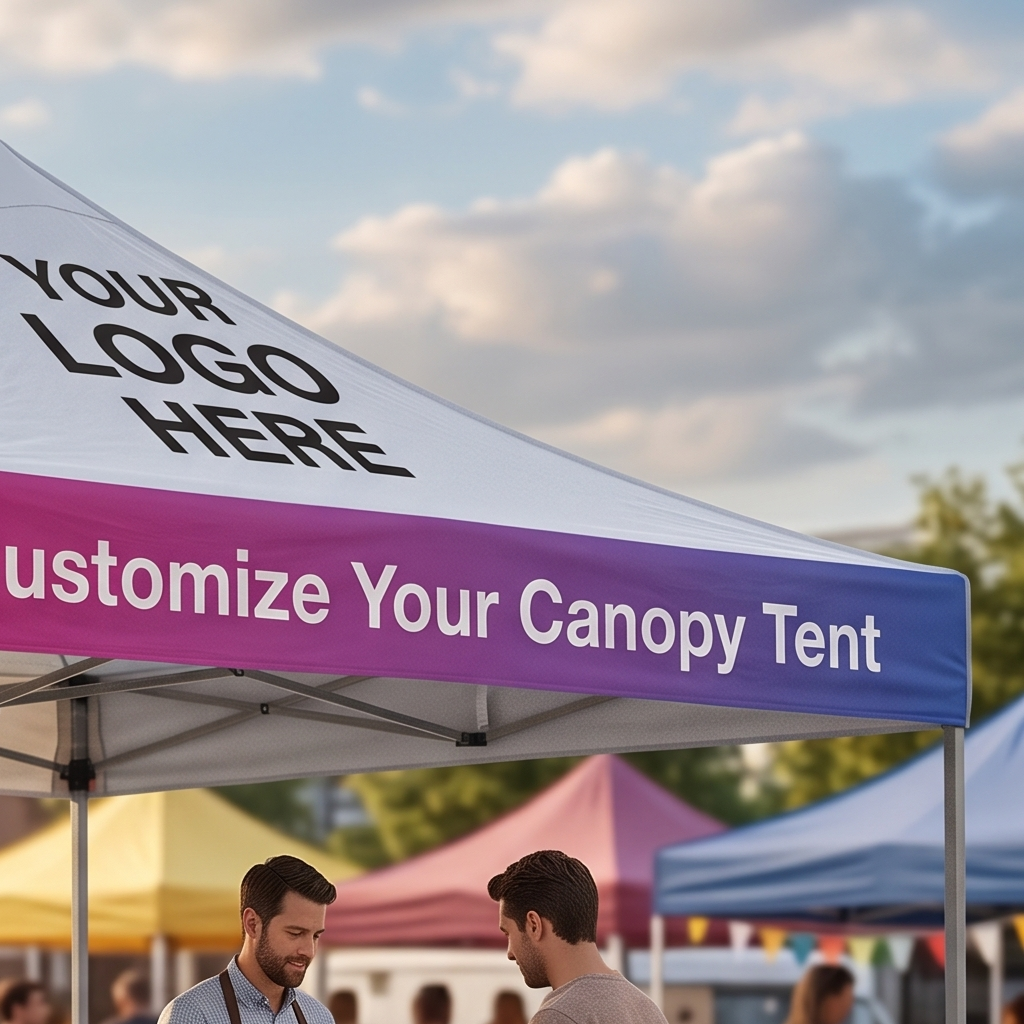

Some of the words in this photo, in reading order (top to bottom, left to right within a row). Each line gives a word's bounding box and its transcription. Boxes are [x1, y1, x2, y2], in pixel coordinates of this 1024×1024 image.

[19, 312, 340, 405] LOGO
[120, 395, 416, 479] HERE
[350, 561, 499, 638] Your
[519, 578, 746, 675] Canopy
[762, 602, 881, 673] Tent
